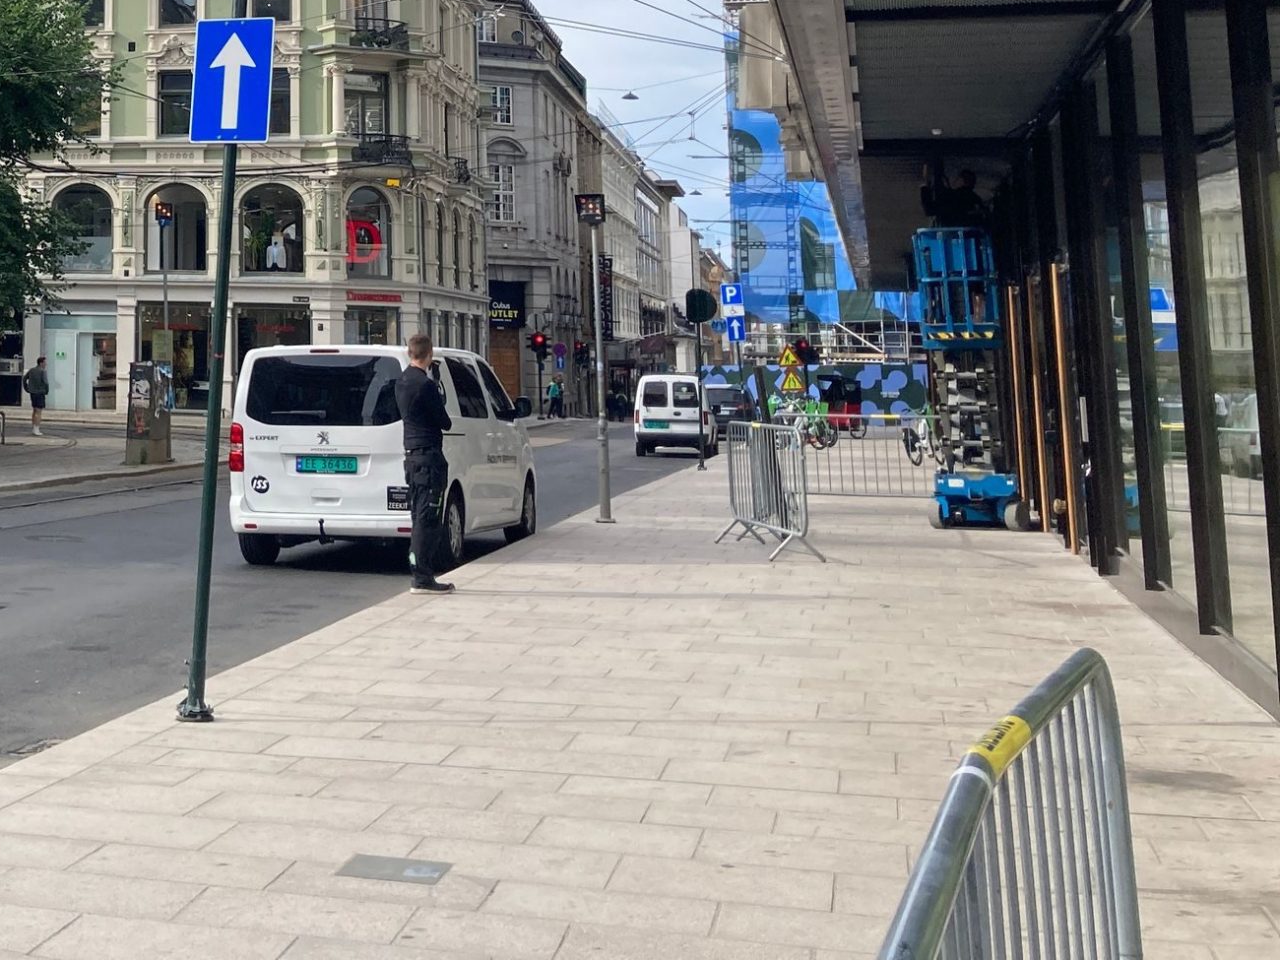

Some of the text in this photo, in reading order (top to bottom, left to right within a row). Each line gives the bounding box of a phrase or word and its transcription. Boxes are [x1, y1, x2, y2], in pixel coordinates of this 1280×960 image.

[725, 286, 737, 303] P
[305, 458, 354, 470] EE 36436
[252, 479, 268, 490] ISS
